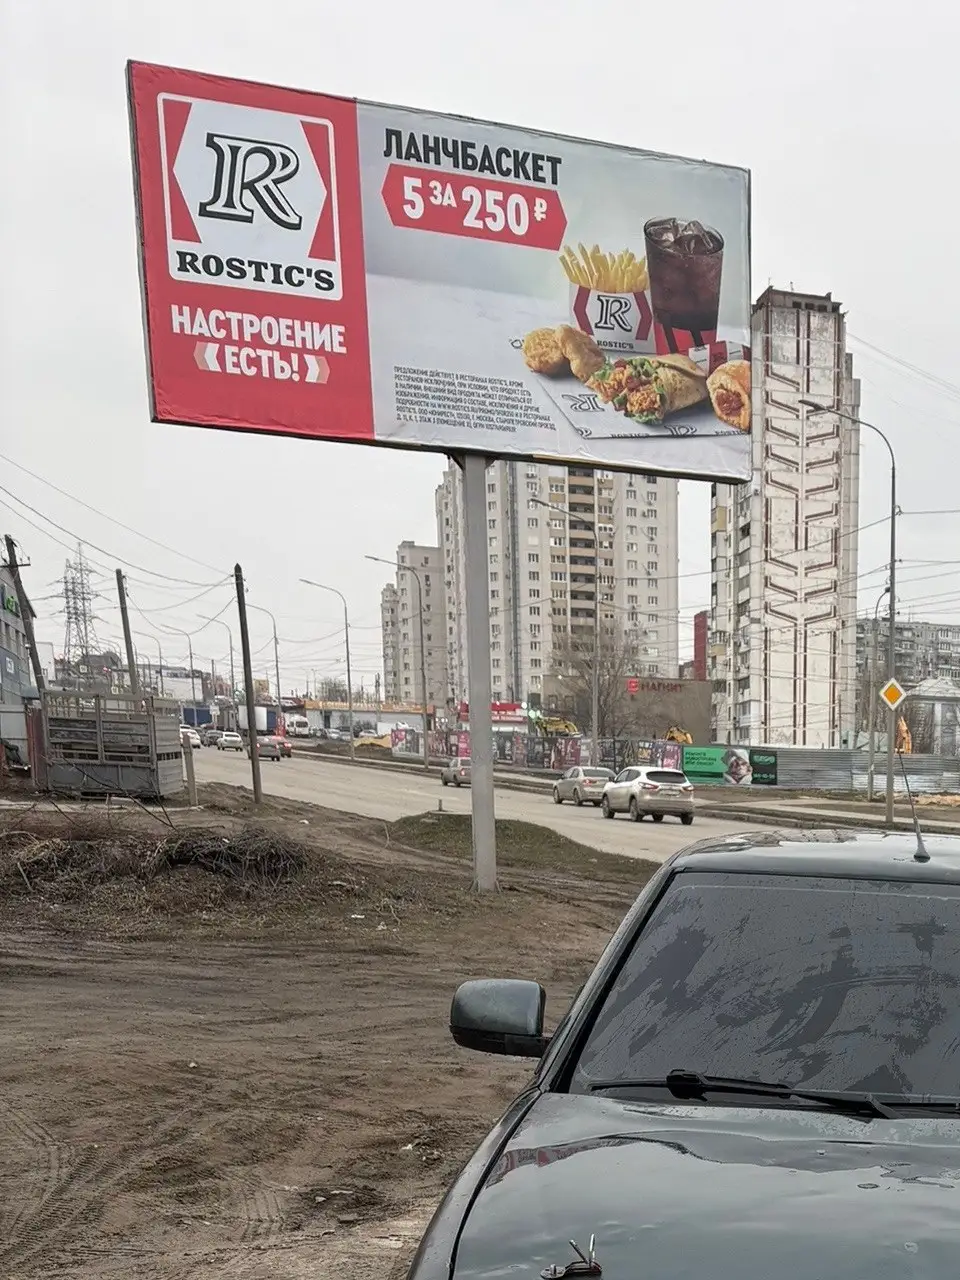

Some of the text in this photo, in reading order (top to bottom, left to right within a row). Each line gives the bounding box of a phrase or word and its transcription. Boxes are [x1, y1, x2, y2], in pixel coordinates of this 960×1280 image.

[383, 128, 562, 185] ЛАНЧБАСКЕТ
[198, 132, 302, 230] R
[403, 176, 425, 219] 5
[429, 180, 457, 208] ЗА
[176, 251, 335, 291] ROSTIC'S
[171, 304, 347, 354] НАСТРОЕНИЕ
[224, 344, 300, 382] ЕСТЬ!
